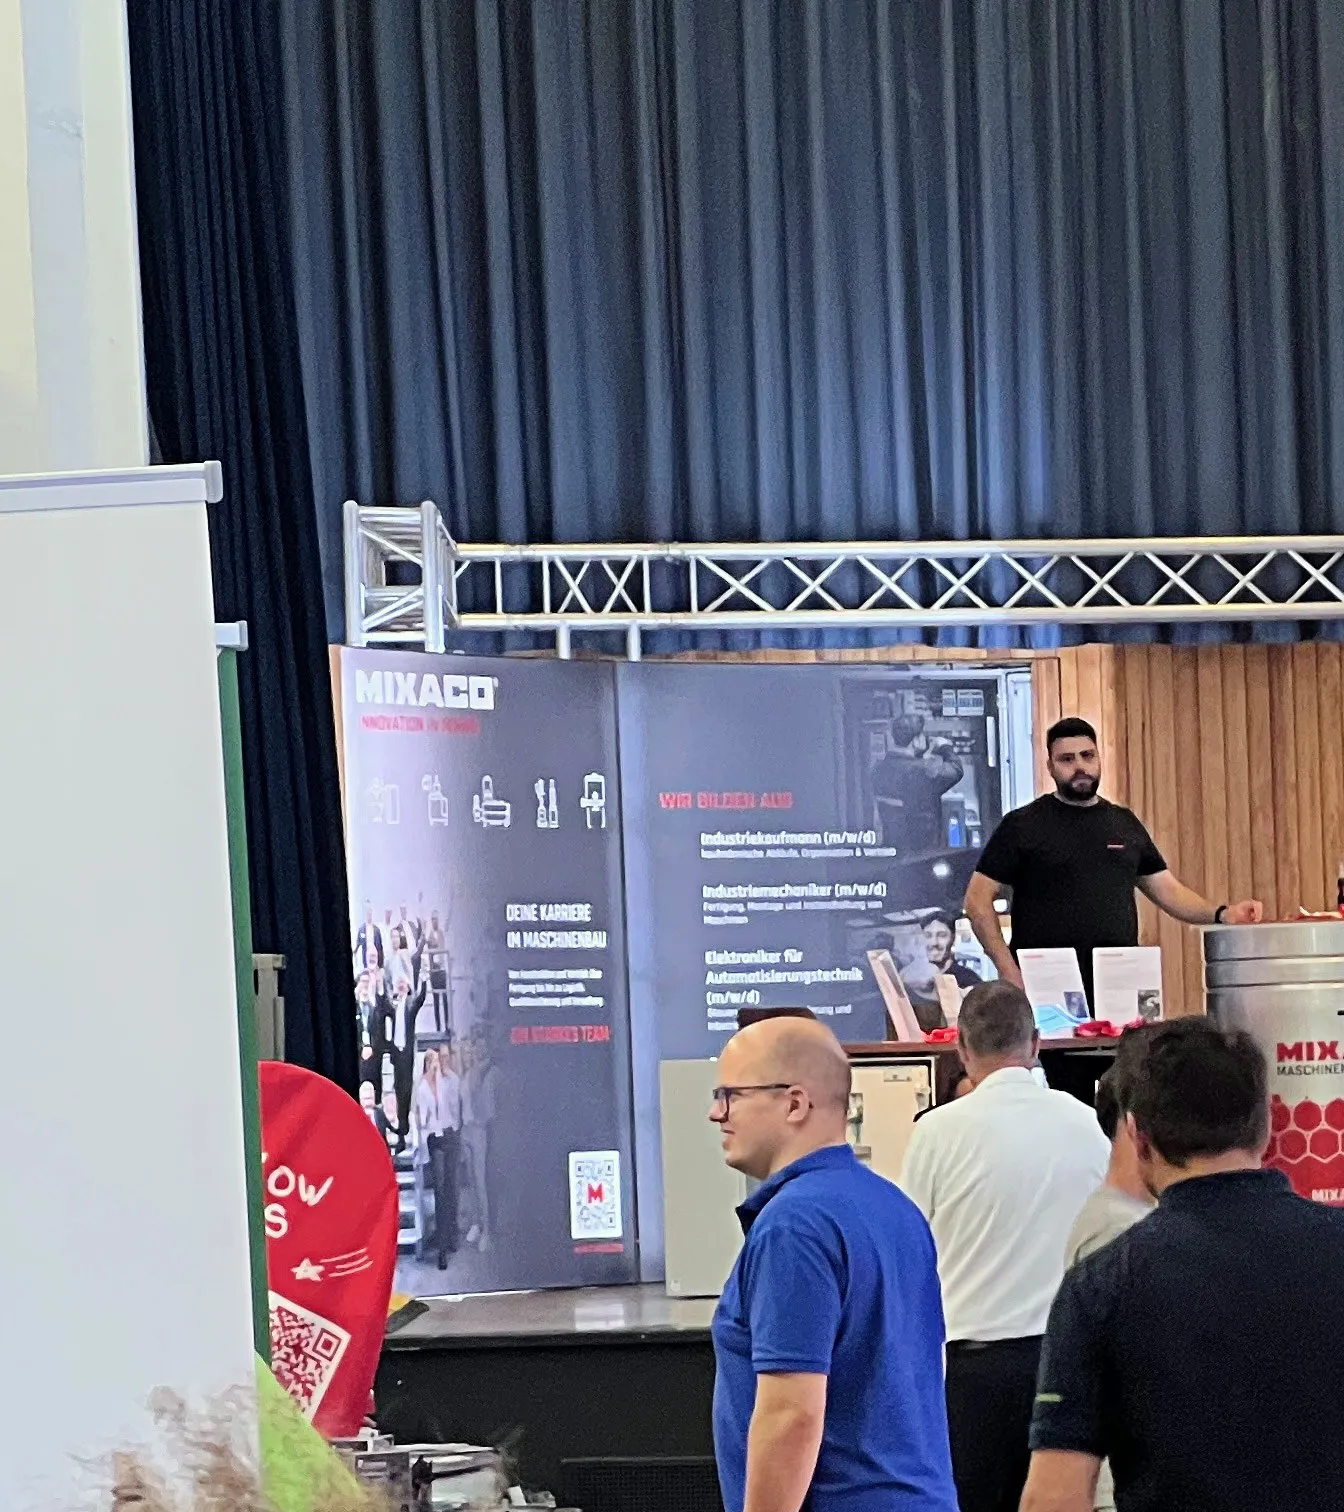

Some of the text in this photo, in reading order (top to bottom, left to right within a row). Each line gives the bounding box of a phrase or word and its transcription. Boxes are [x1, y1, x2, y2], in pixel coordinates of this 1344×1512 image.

[355, 670, 495, 710] MIXACO
[659, 792, 692, 809] WIR
[823, 831, 876, 845] (m/w/d)
[702, 882, 887, 898] Industriemechaniker (m/w/d)
[506, 903, 592, 922] DEINE KARRIERE
[507, 931, 607, 948] IM MASCHINENBAU
[706, 990, 760, 1004] (m/w/d)
